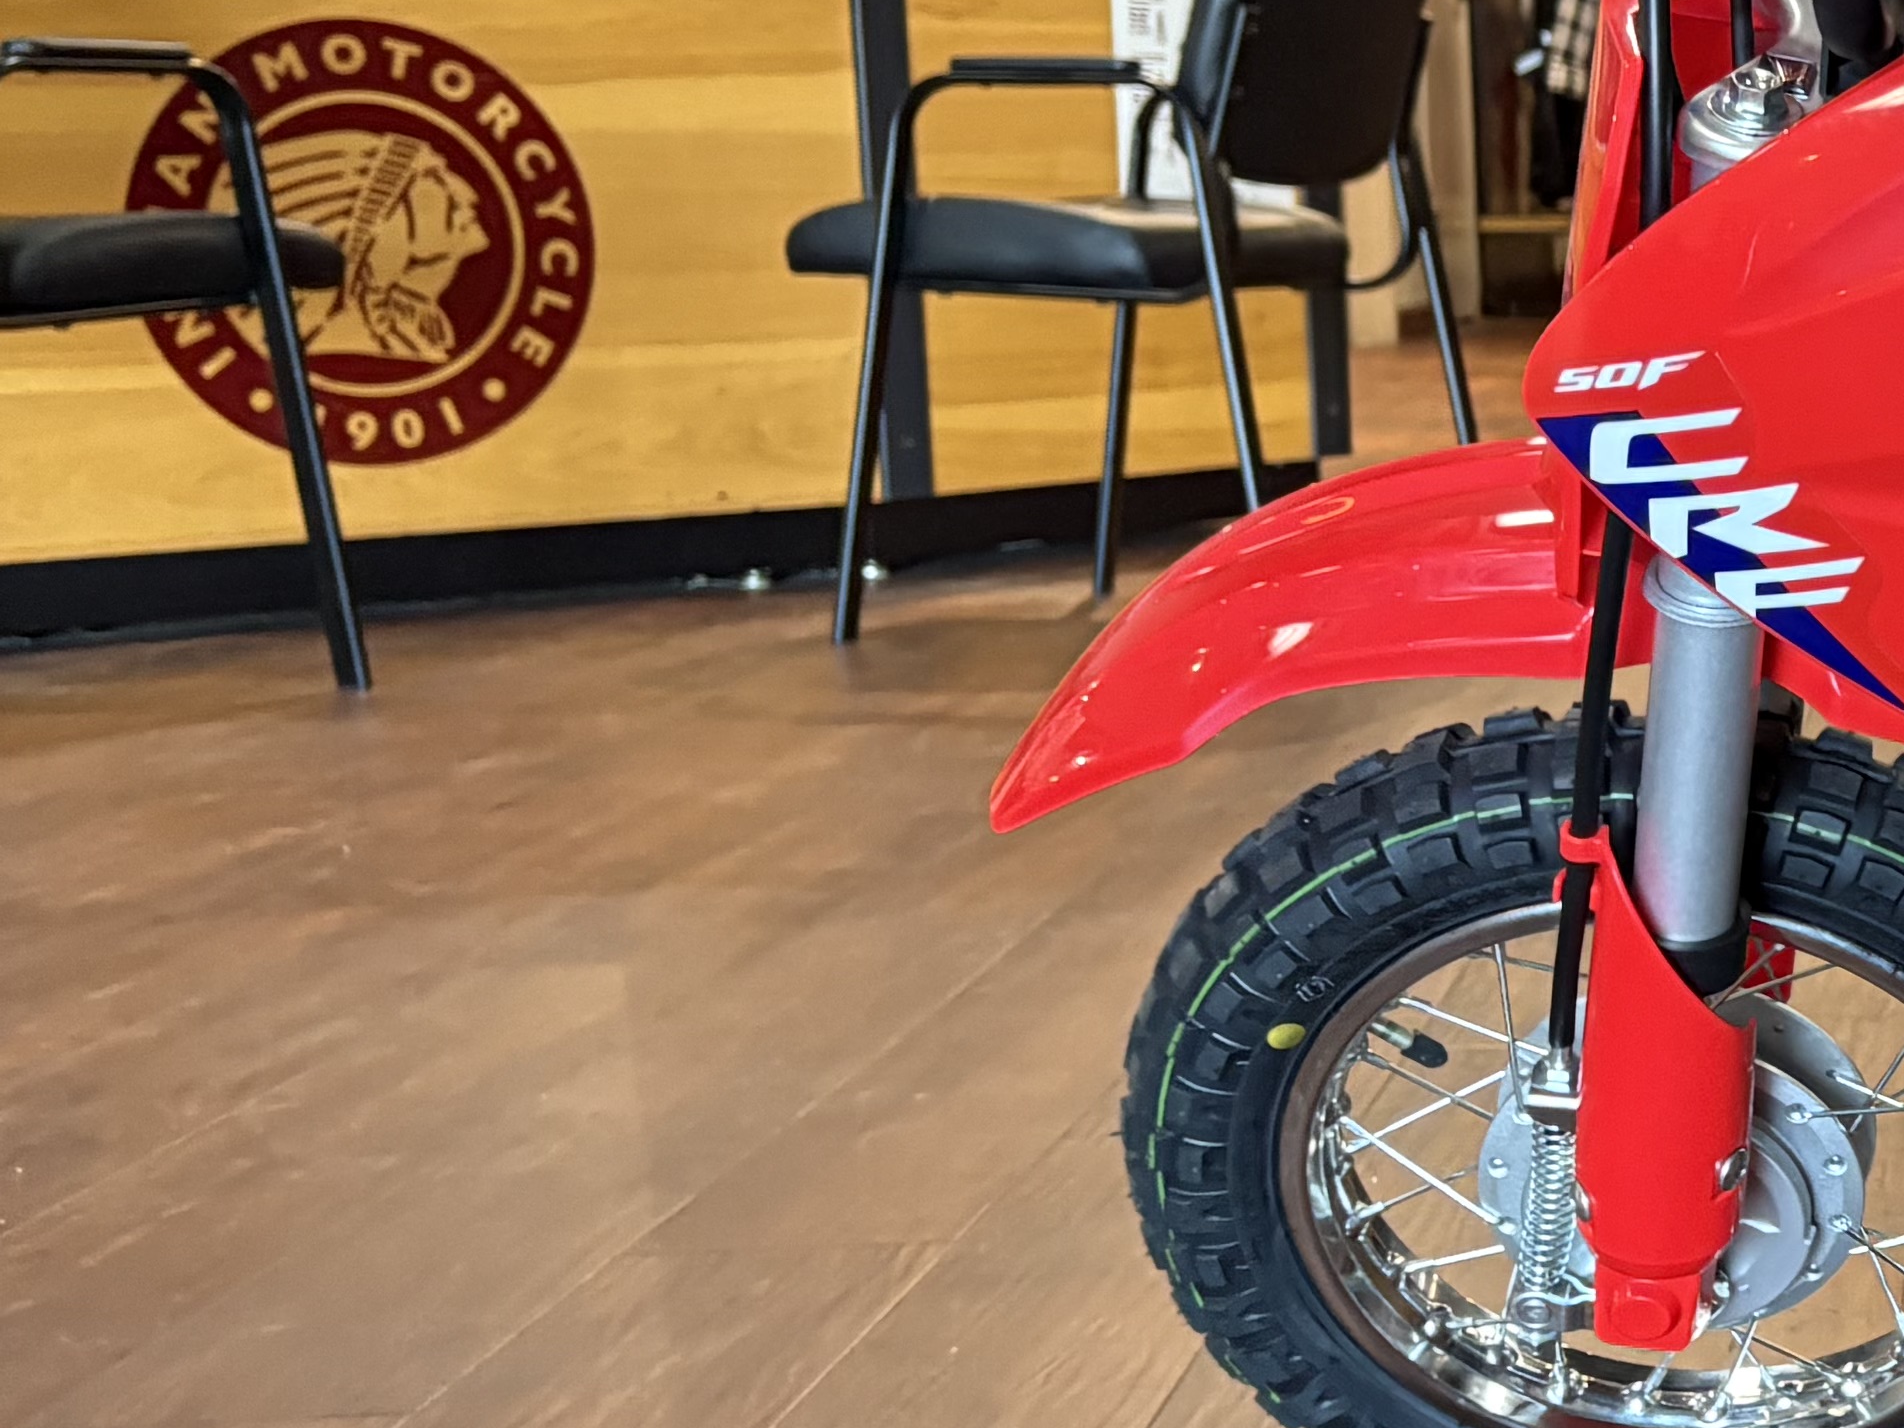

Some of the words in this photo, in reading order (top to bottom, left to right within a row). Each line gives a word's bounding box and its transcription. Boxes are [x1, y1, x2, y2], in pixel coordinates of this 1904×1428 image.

[252, 33, 580, 368] MOTORCYCLE
[1553, 350, 1706, 394] 50F
[1589, 406, 1866, 618] CRF
